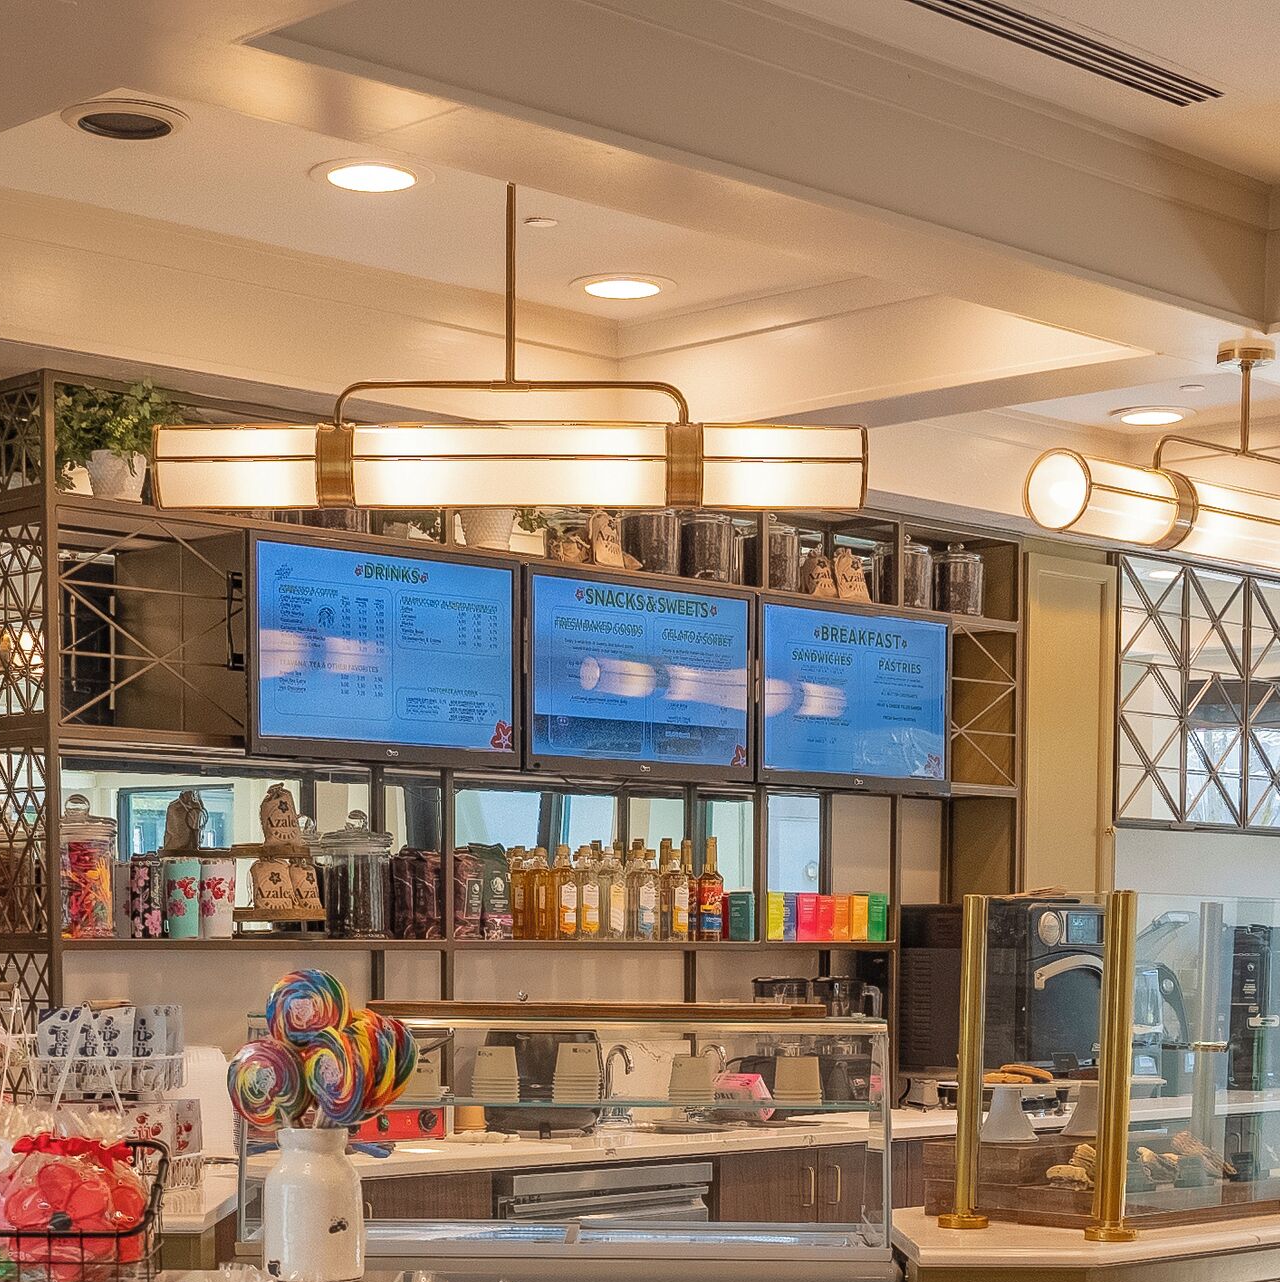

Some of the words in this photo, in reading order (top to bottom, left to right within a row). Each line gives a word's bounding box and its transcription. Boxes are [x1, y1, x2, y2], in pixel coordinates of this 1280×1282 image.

[363, 562, 420, 584] DRINKS
[584, 588, 644, 611] SNACKS
[646, 597, 656, 612] &
[658, 598, 709, 618] SWEETS
[820, 625, 901, 650] BREAKFAST
[792, 650, 852, 666] SANDWICHES
[878, 658, 921, 675] PASTRIES
